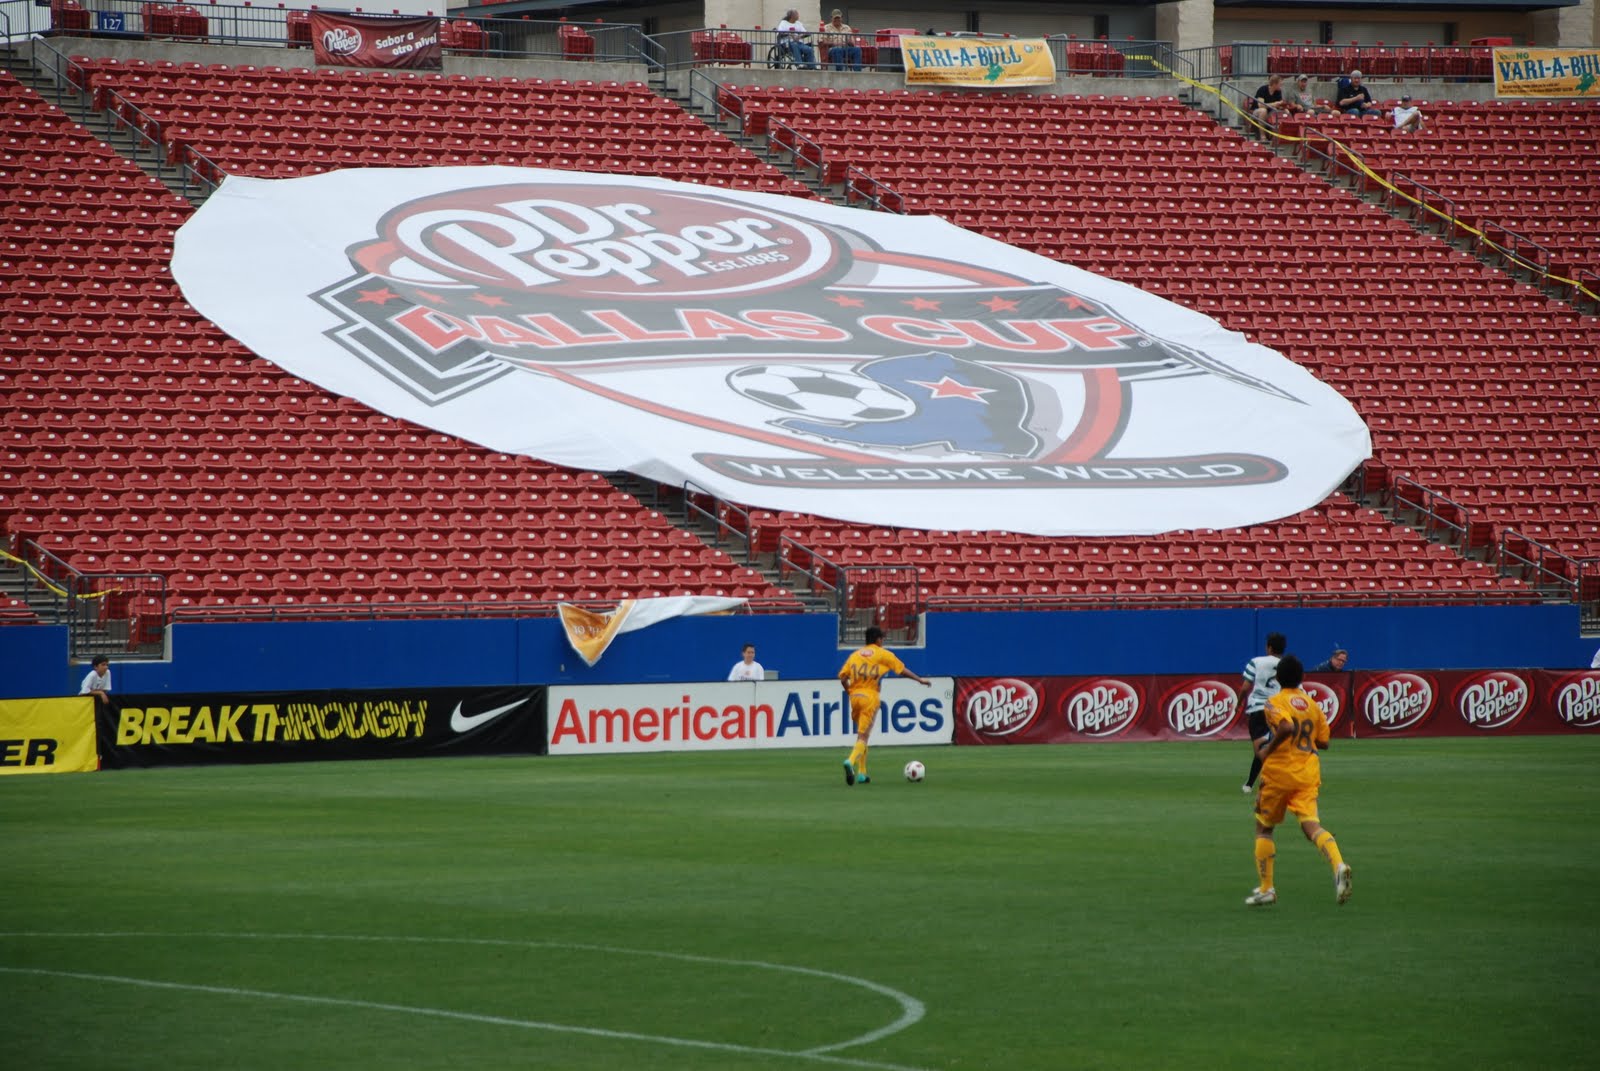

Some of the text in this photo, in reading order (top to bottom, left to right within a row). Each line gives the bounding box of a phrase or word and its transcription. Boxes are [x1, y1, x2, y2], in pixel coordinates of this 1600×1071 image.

[103, 18, 122, 30] 127
[335, 28, 349, 42] Dr
[375, 31, 414, 49] Sabor a
[392, 44, 413, 56] otro
[907, 44, 1023, 69] VARI-A-BULL
[493, 198, 659, 244] Dr
[396, 208, 778, 287] Pepper
[386, 303, 1138, 354] DALLAS CUP
[725, 461, 1245, 481] WELCOME WORLD
[991, 685, 1016, 709] Dr
[1093, 686, 1117, 710] Dr
[1192, 687, 1217, 711] Dr
[1388, 680, 1412, 703] Dr
[1484, 679, 1508, 702] Dr
[967, 690, 1033, 730] Pepper
[1068, 691, 1133, 732] Pepper
[1168, 692, 1233, 732] Pepper
[1365, 685, 1427, 725] Pepper
[1461, 684, 1523, 723] Pepper
